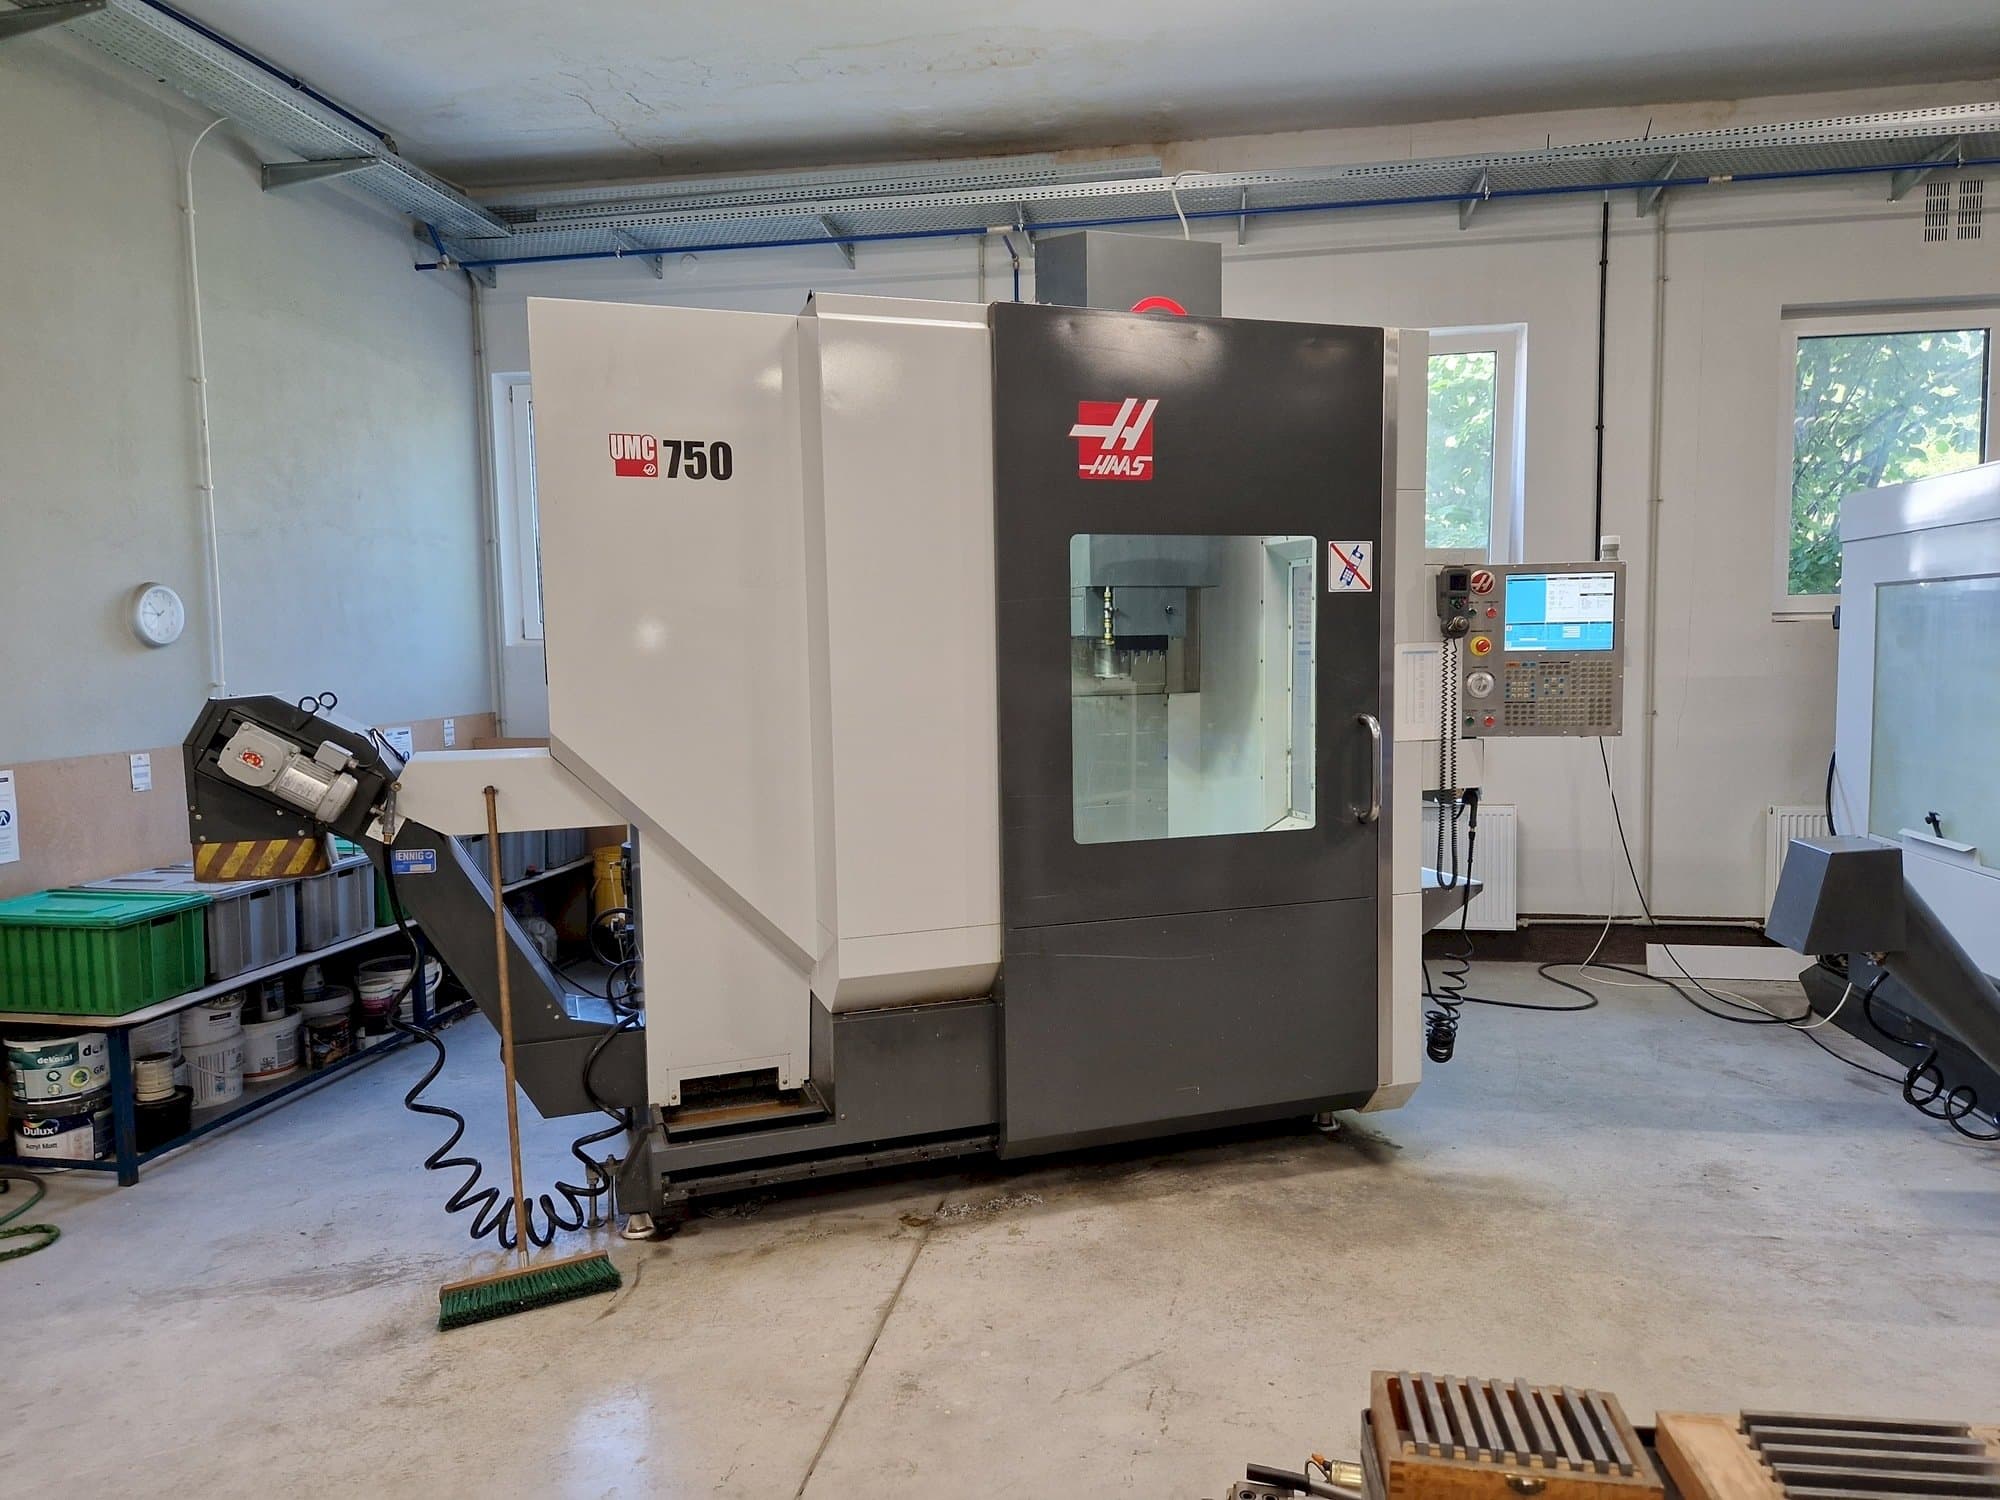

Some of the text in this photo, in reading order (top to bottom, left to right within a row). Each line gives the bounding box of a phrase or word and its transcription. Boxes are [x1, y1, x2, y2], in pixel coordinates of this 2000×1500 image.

[609, 433, 733, 481] UMC 750
[1080, 454, 1152, 476] HAAS
[23, 1126, 55, 1136] Dulux
